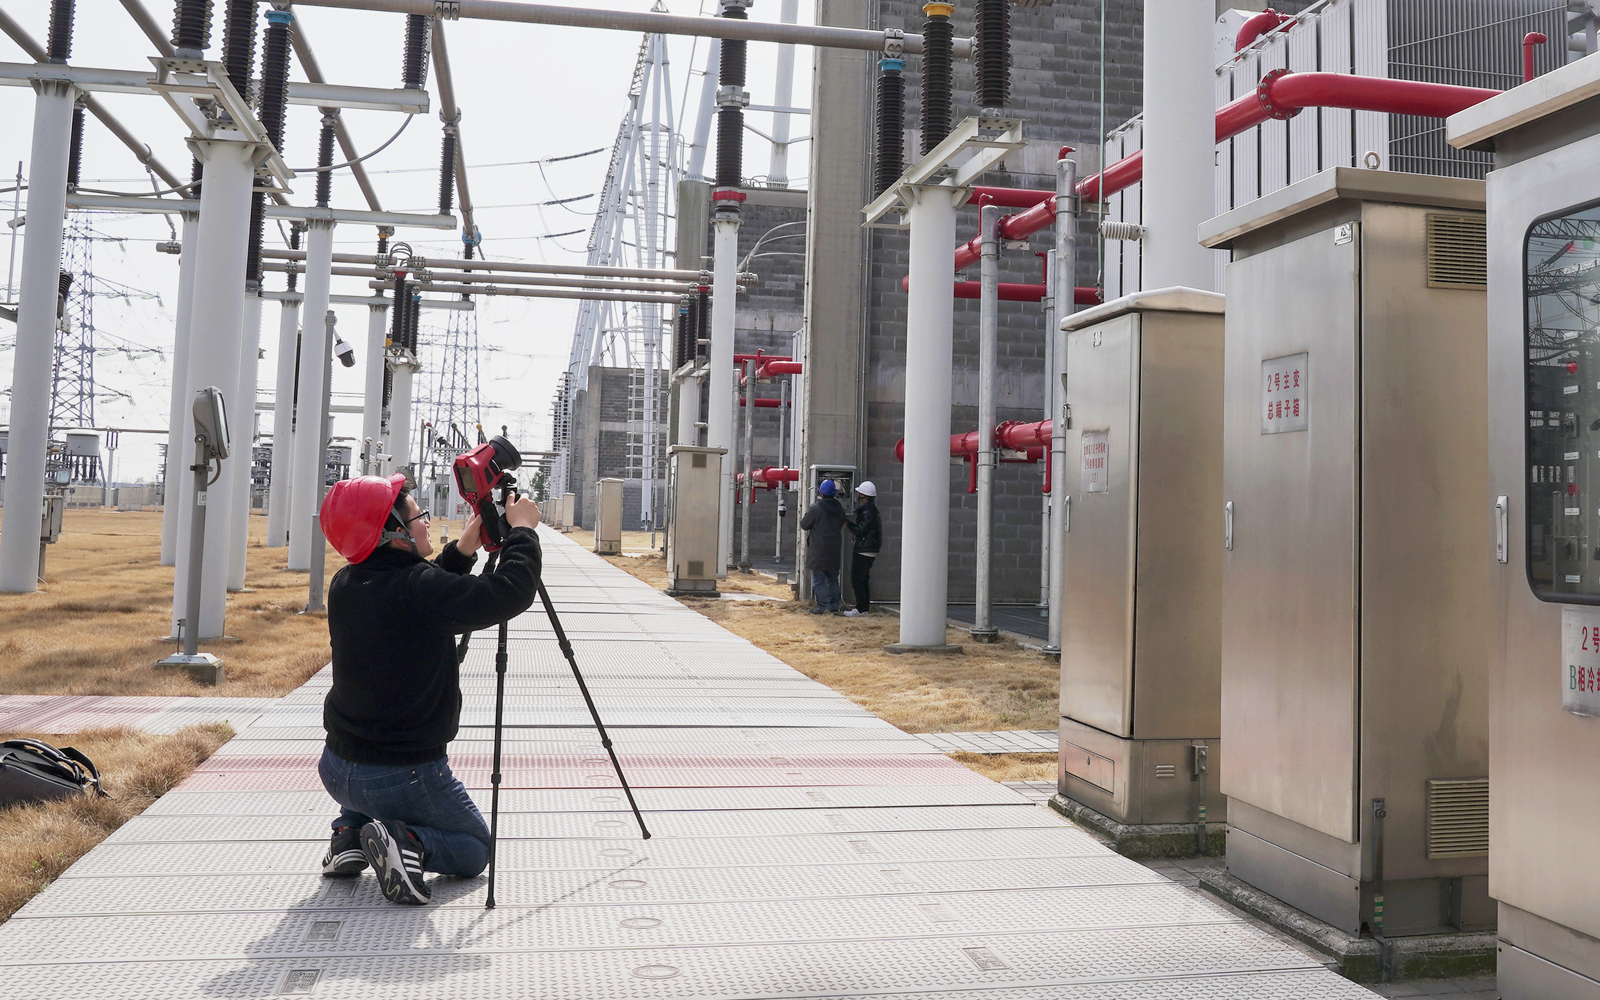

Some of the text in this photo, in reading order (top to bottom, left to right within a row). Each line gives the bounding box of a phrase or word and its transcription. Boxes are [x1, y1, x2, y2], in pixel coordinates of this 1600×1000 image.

[1267, 369, 1300, 393] 2号主变
[1267, 398, 1300, 420] 总端子箱
[1581, 626, 1600, 653] 2号
